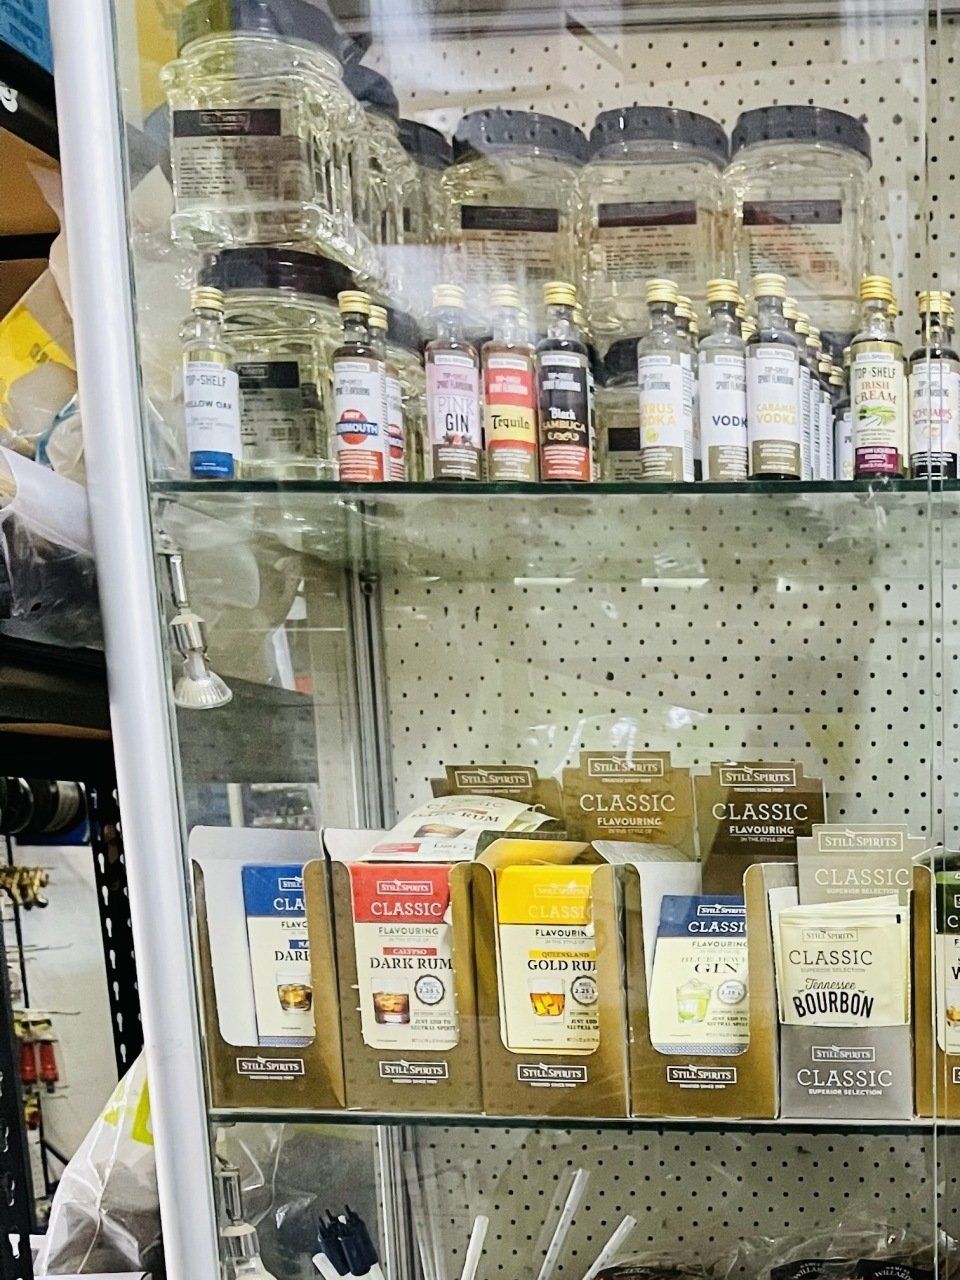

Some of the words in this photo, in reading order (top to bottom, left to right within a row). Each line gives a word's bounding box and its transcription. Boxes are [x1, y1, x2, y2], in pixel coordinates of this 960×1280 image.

[861, 381, 889, 389] IRISH
[855, 390, 896, 405] CREAM
[439, 396, 474, 414] PINK
[549, 407, 576, 420] Black
[756, 414, 797, 425] VODKA
[446, 413, 469, 432] GIN
[491, 415, 529, 430] Tequila
[713, 415, 748, 428] VODK
[592, 762, 619, 773] STILL
[621, 762, 659, 773] SPIRITS
[461, 773, 488, 785] STILL
[489, 774, 526, 786] SPIRITS
[724, 771, 751, 783] STILL
[752, 772, 792, 784] SPIRITS
[580, 794, 676, 812] CLASSIC
[712, 803, 808, 821] CLASSIC
[597, 817, 662, 827] FLAVOURING
[729, 825, 794, 835] FLAVOURING
[824, 835, 856, 847] STILL
[857, 836, 897, 848] SPIRITS
[815, 868, 909, 886] CLASSIC
[381, 883, 399, 892] STILL
[401, 883, 429, 892] SPIRITS
[370, 902, 442, 916] CLASSIC
[701, 906, 720, 914] STILL
[379, 927, 439, 936] FLAVOURING
[806, 931, 826, 940] STILL
[827, 931, 854, 940] SPIRITS
[393, 948, 427, 956] CALYPSO
[789, 950, 873, 966] CLASSIC
[370, 957, 414, 969] DARK
[417, 957, 453, 970] RUM
[528, 960, 567, 972] GOLD
[694, 963, 739, 973] GIN
[805, 977, 856, 991] Tennessee
[793, 990, 874, 1019] BOURBON
[816, 1049, 839, 1059] STILL
[839, 1050, 871, 1059] SPIRITS
[241, 1061, 265, 1071] STILL
[266, 1061, 299, 1072] SPIRITS
[384, 1064, 409, 1075] STILL
[409, 1065, 443, 1075] SPIRITS
[522, 1067, 547, 1078] STILL
[548, 1068, 582, 1079] SPIRITS
[672, 1069, 697, 1079] STILL
[698, 1070, 732, 1080] SPIRITS
[796, 1069, 893, 1088] CLASSIC
